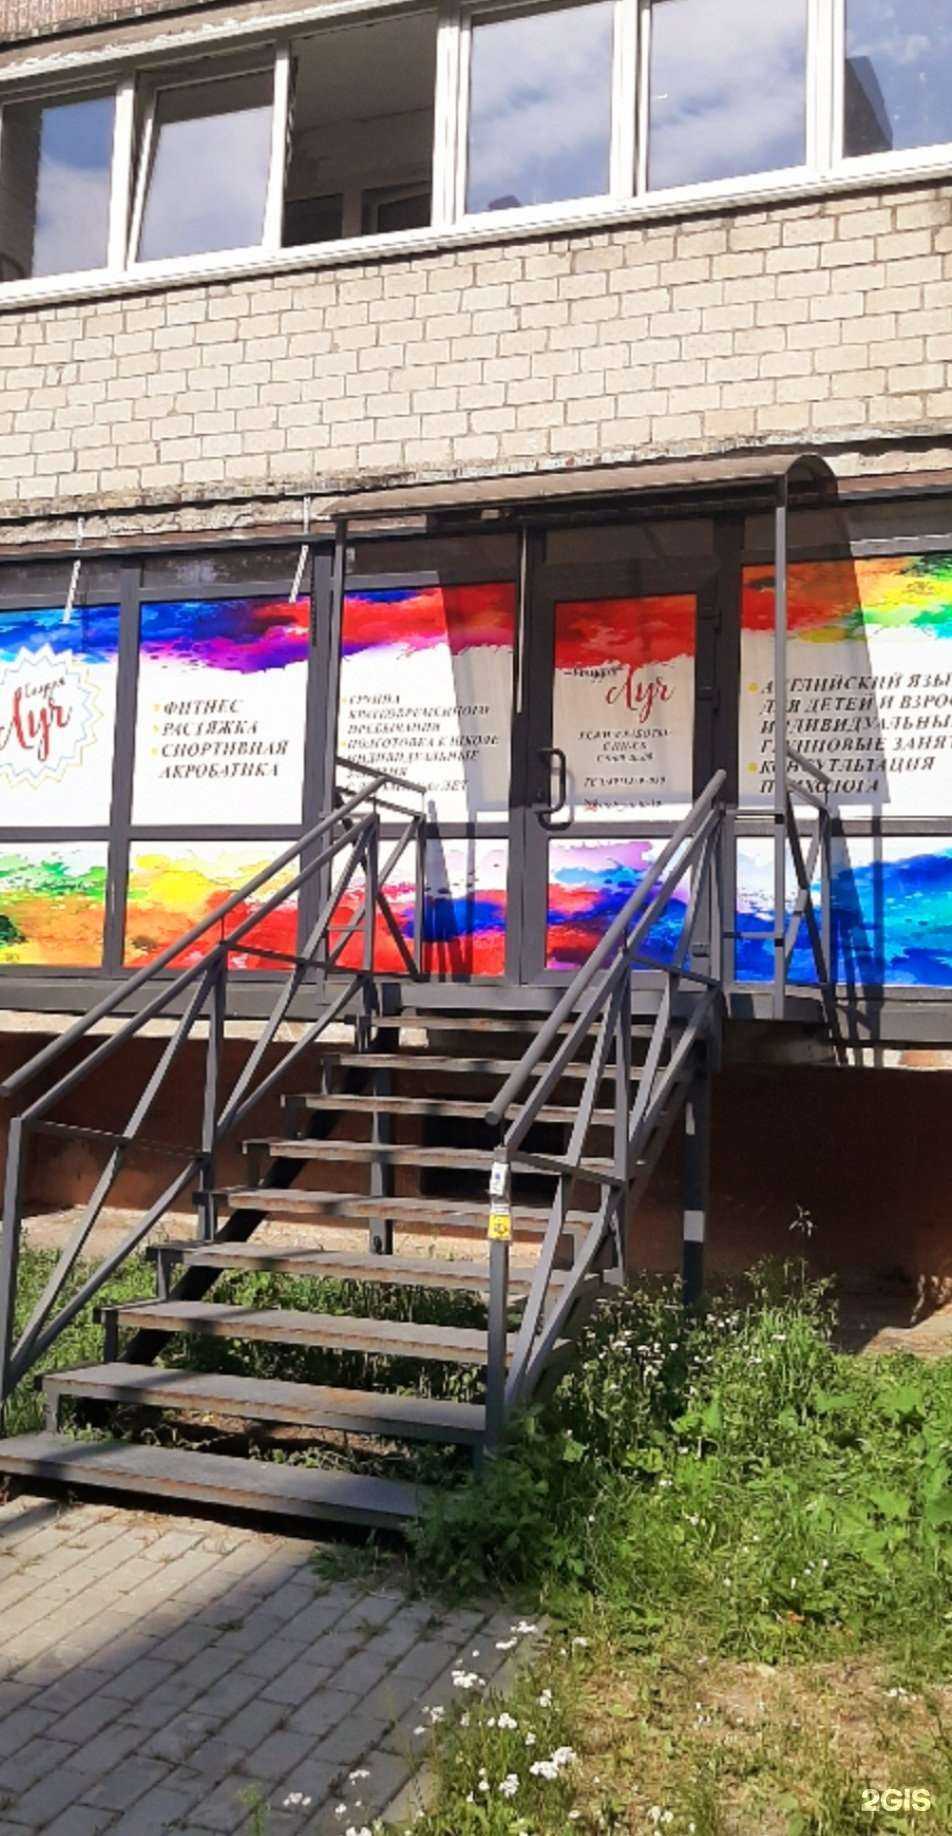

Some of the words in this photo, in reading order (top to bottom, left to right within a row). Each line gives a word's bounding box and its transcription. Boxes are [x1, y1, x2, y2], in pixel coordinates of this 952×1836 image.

[761, 672, 902, 694] АГЛИЙСКИЙ
[163, 699, 243, 715] ФИТНЕС
[760, 699, 801, 715] ДЯ
[804, 693, 874, 713] ДЕТЕЙ
[880, 695, 895, 709] И
[900, 693, 952, 709] ВЗРО
[162, 720, 258, 736] РАСТЯЖКА
[162, 740, 288, 757] СПОРТИВНАЯ
[762, 736, 887, 753] ГУППОВЫЕ
[893, 735, 952, 751] ЗАНЯ
[158, 762, 279, 779] АКРОБАТИКА
